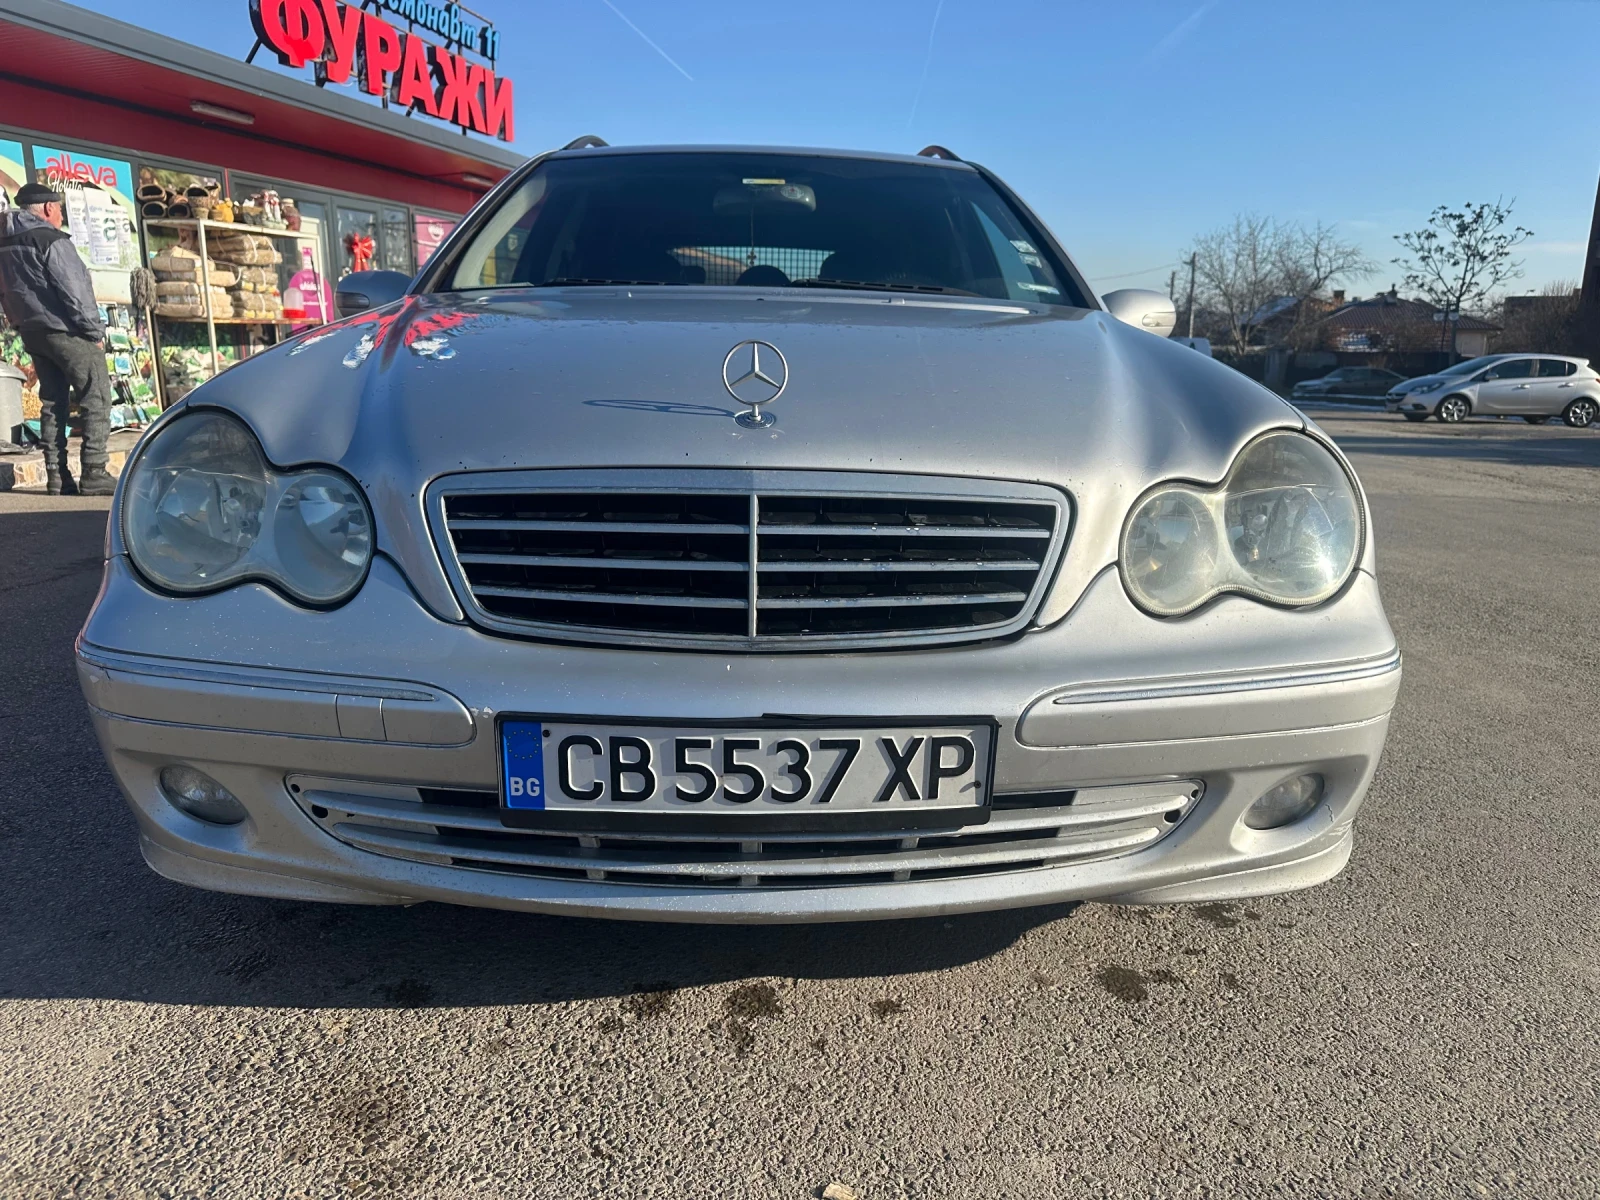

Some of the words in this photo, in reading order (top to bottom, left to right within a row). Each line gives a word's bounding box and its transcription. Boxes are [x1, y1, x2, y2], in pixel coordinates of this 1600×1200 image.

[485, 27, 500, 61] 11
[259, 0, 515, 142] ФУРАЖИ
[46, 153, 117, 187] alleva
[558, 734, 656, 802] CB
[675, 737, 861, 803] 5537
[879, 735, 976, 802] XP
[509, 777, 540, 797] BG
